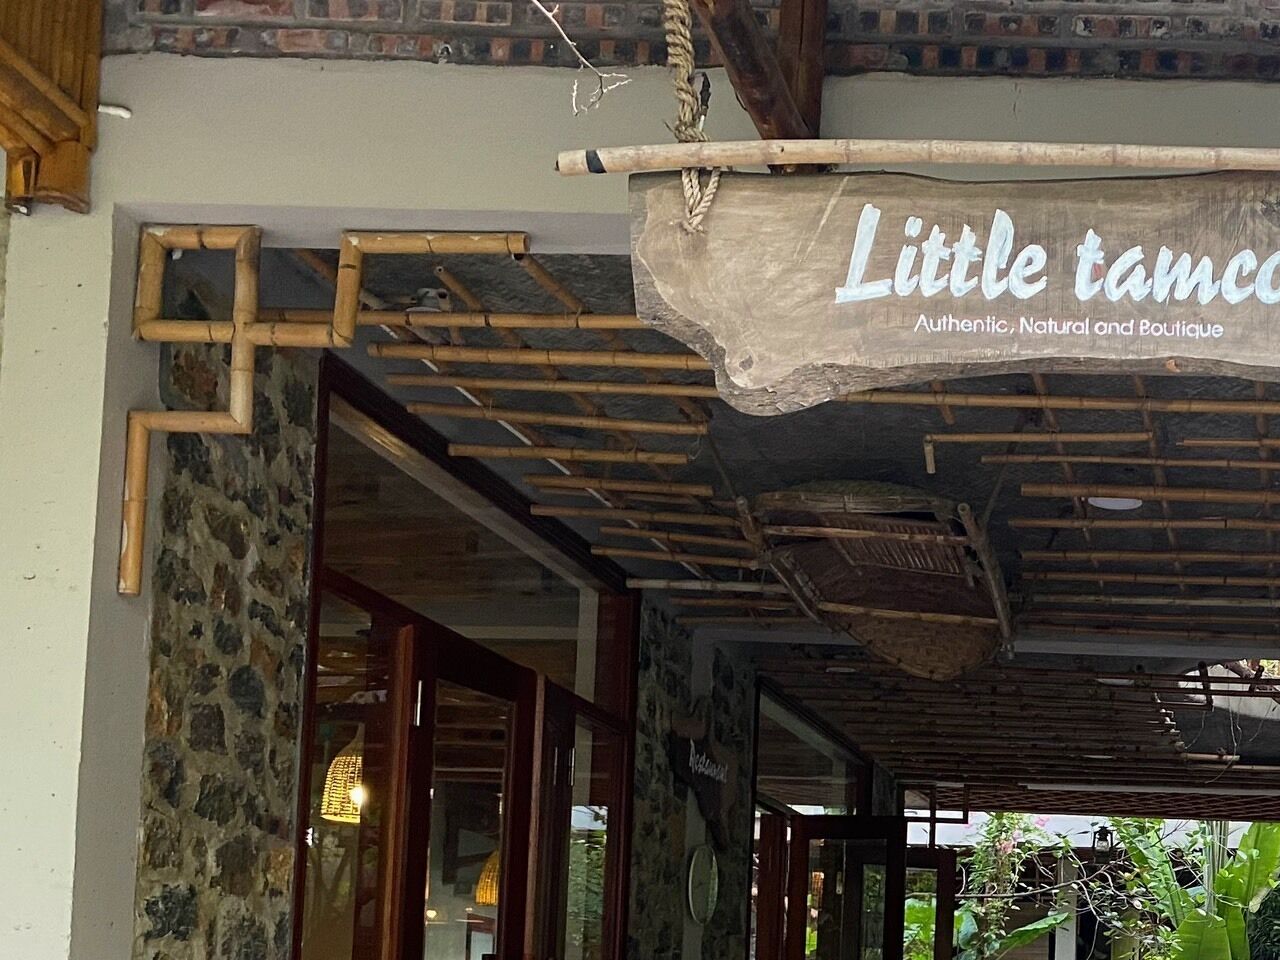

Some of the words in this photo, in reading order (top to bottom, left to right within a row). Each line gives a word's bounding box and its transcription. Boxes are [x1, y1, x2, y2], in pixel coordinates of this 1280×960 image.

[835, 203, 1048, 303] Little
[914, 312, 1015, 335] Authentic,
[1019, 317, 1089, 335] Natural
[1096, 317, 1135, 336] and
[1139, 318, 1224, 339] Boutique
